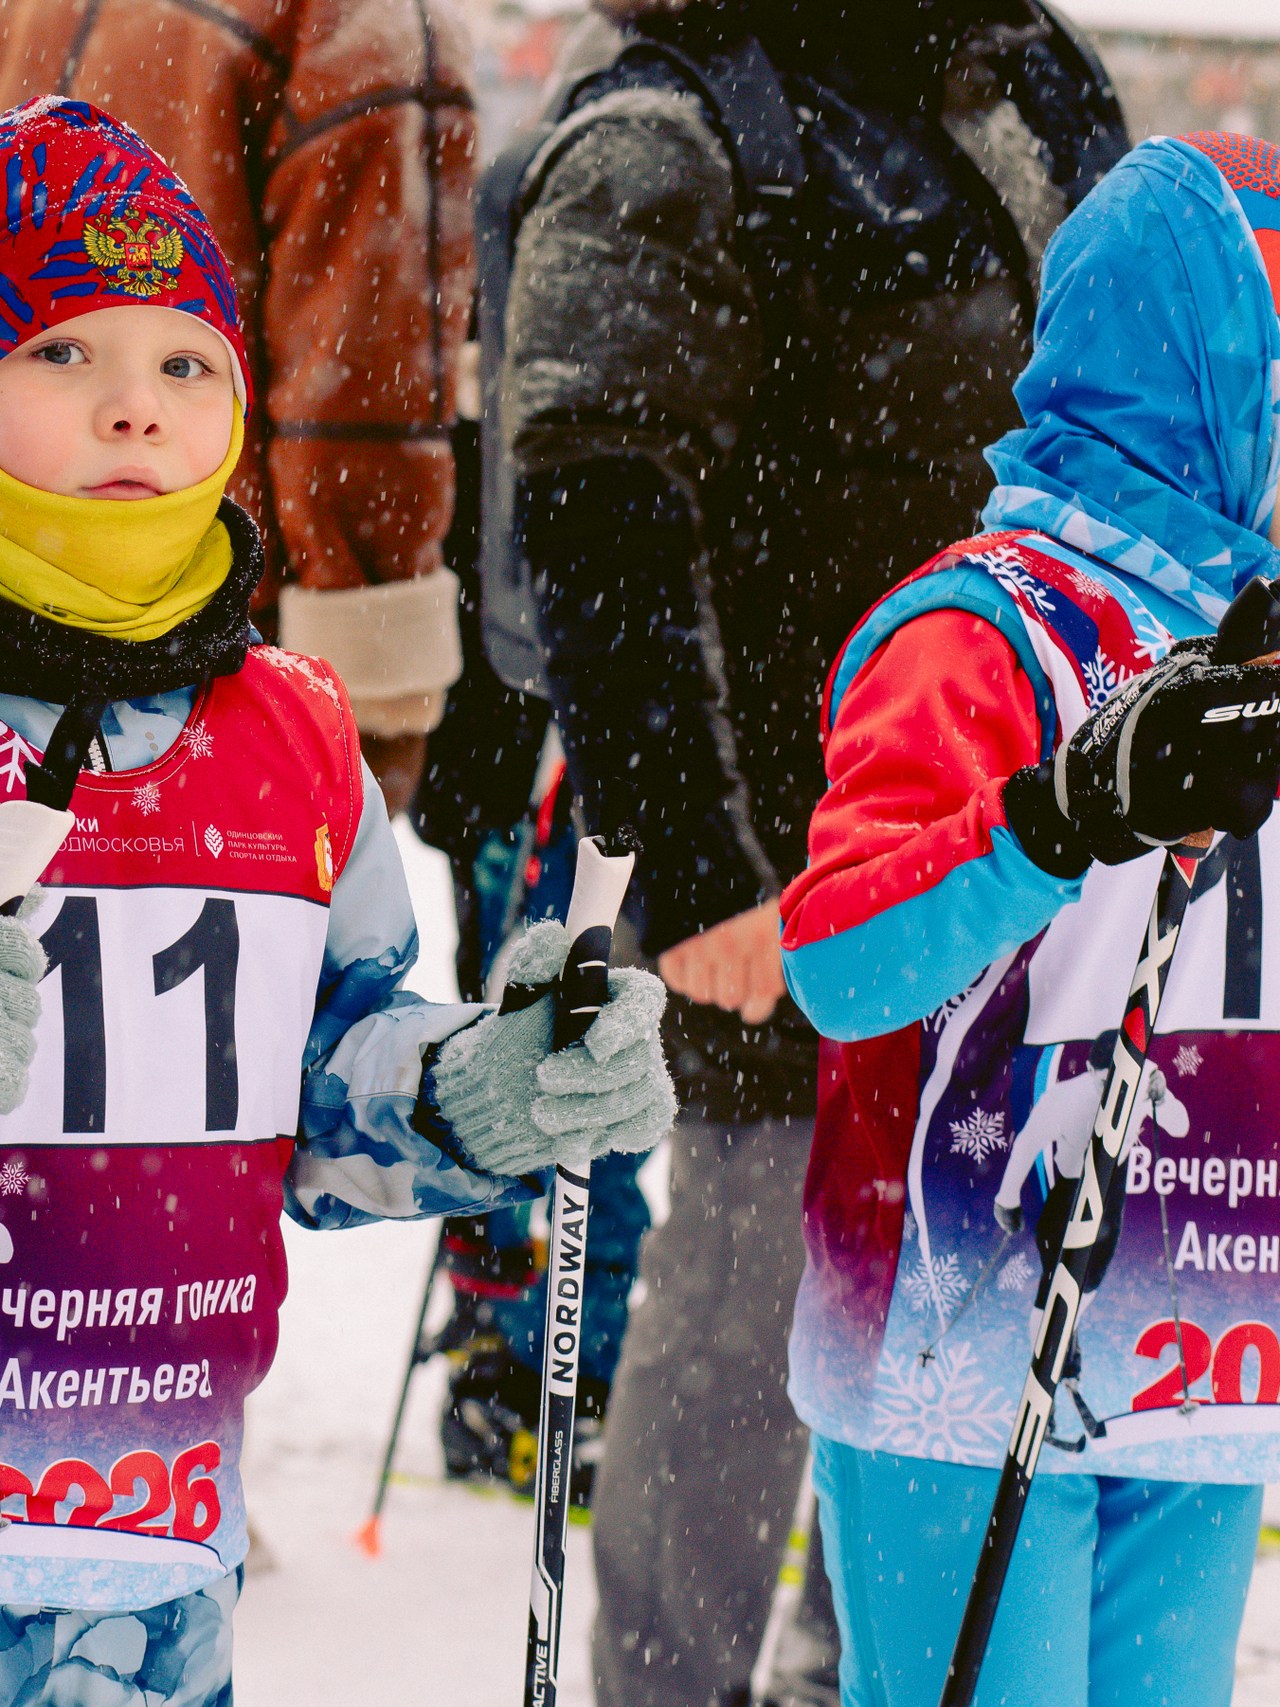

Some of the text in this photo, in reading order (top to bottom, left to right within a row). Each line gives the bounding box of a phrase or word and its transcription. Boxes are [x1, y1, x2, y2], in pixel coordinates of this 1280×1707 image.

[1200, 697, 1280, 724] SW
[73, 817, 100, 833] КИ
[227, 840, 246, 849] ПАРК
[229, 850, 257, 860] СПОРТА
[265, 854, 297, 862] ОТДЫХА
[37, 895, 240, 1134] 11
[1125, 1146, 1280, 1208] Вечерн
[174, 1273, 257, 1325] гонка
[551, 1193, 585, 1384] NORDWAY
[551, 1430, 564, 1504] FIBERGLASS
